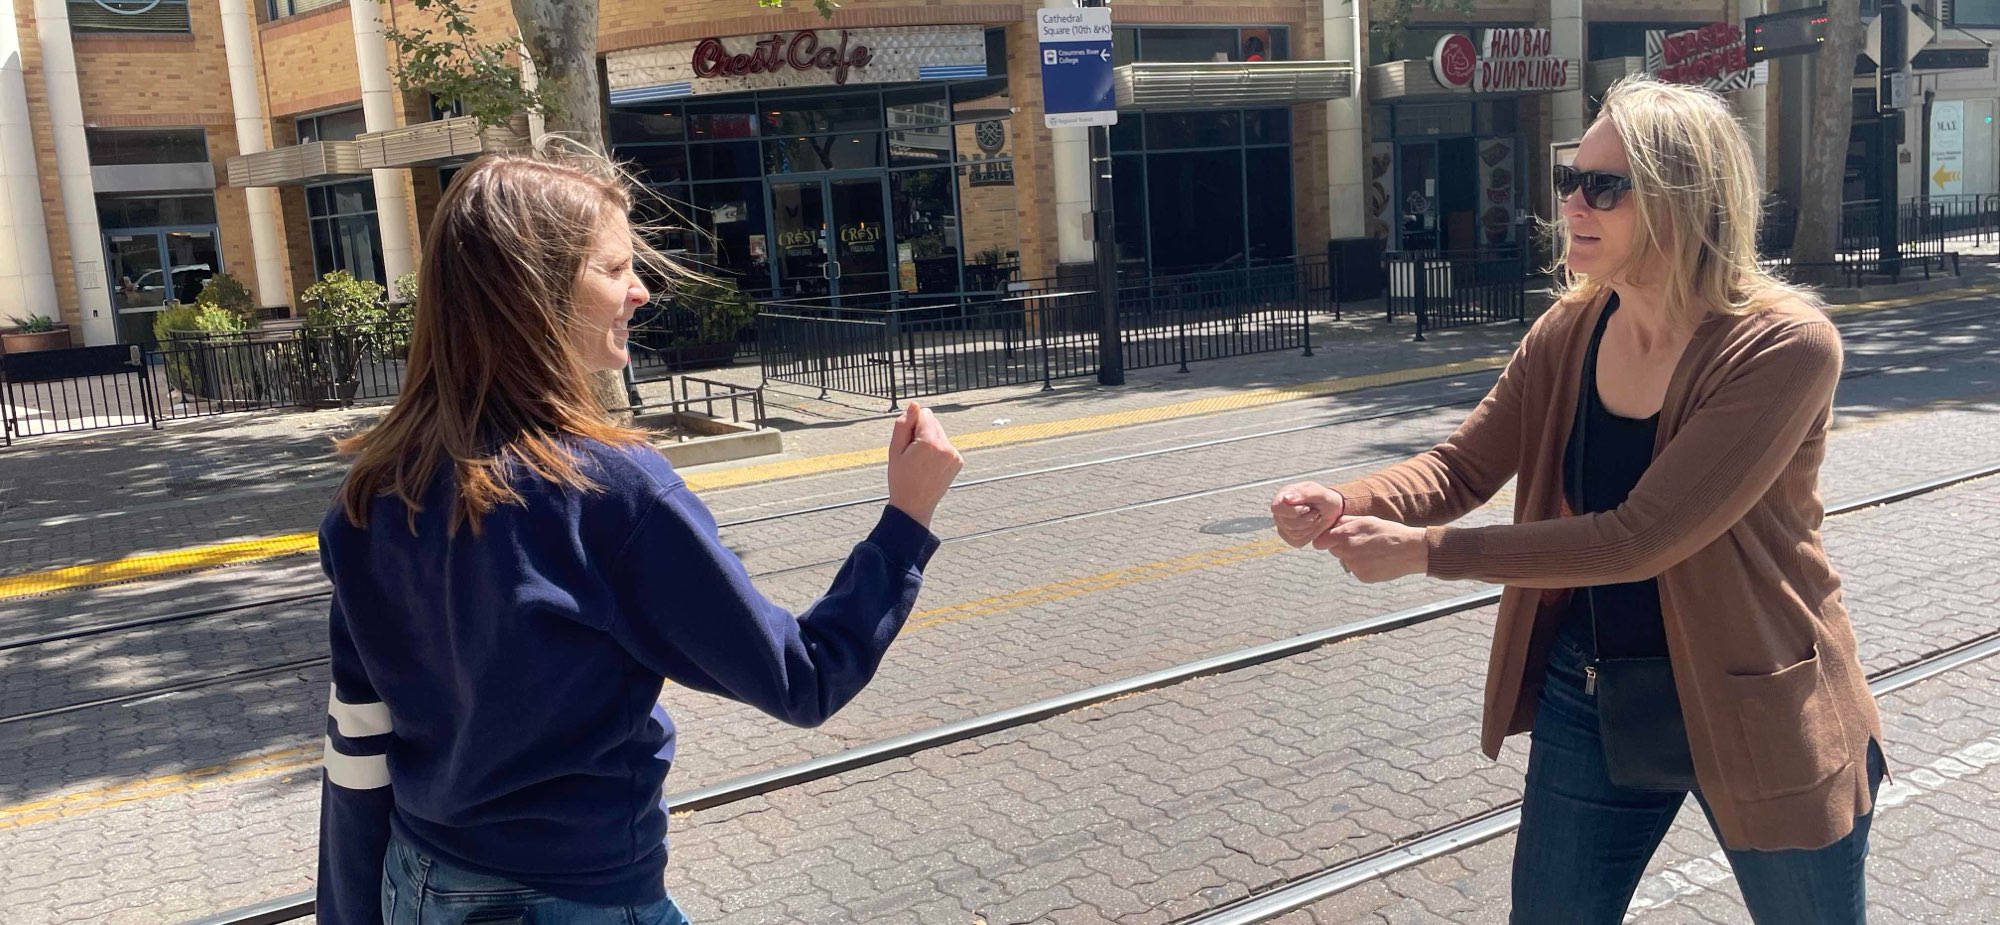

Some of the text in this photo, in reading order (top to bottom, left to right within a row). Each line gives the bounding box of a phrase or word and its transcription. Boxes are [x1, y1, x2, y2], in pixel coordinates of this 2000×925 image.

[1042, 14, 1082, 23] Cathedral
[1043, 26, 1070, 36] Square
[1071, 25, 1091, 35] (10th
[1491, 30, 1520, 58] HAO
[1523, 30, 1550, 56] BAO
[692, 29, 872, 85] Crest Cafe
[1058, 57, 1079, 65] College
[1482, 60, 1568, 89] DUMPLINGS
[778, 229, 816, 246] CREST
[841, 227, 880, 242] CREST
